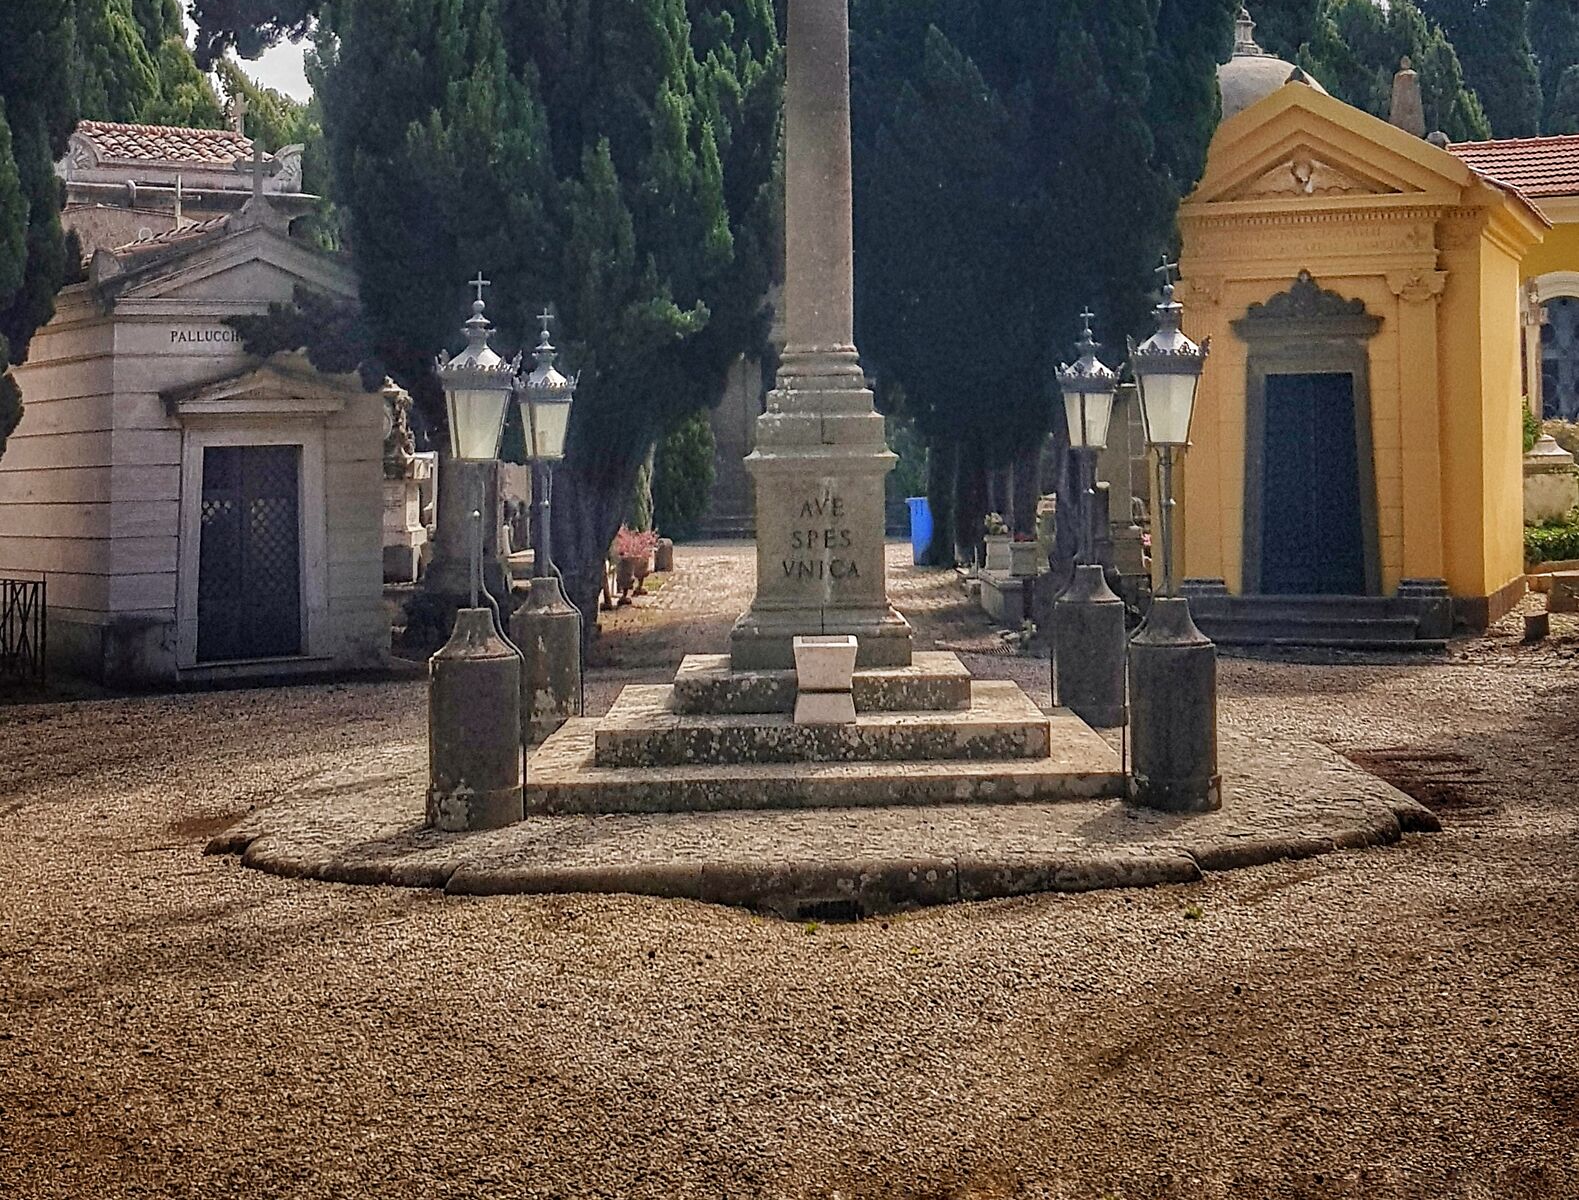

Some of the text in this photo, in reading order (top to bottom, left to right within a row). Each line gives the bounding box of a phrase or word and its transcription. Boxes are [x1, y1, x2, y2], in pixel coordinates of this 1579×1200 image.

[800, 492, 844, 518] AVE
[791, 529, 851, 549] SPES
[782, 560, 860, 580] VNICA
